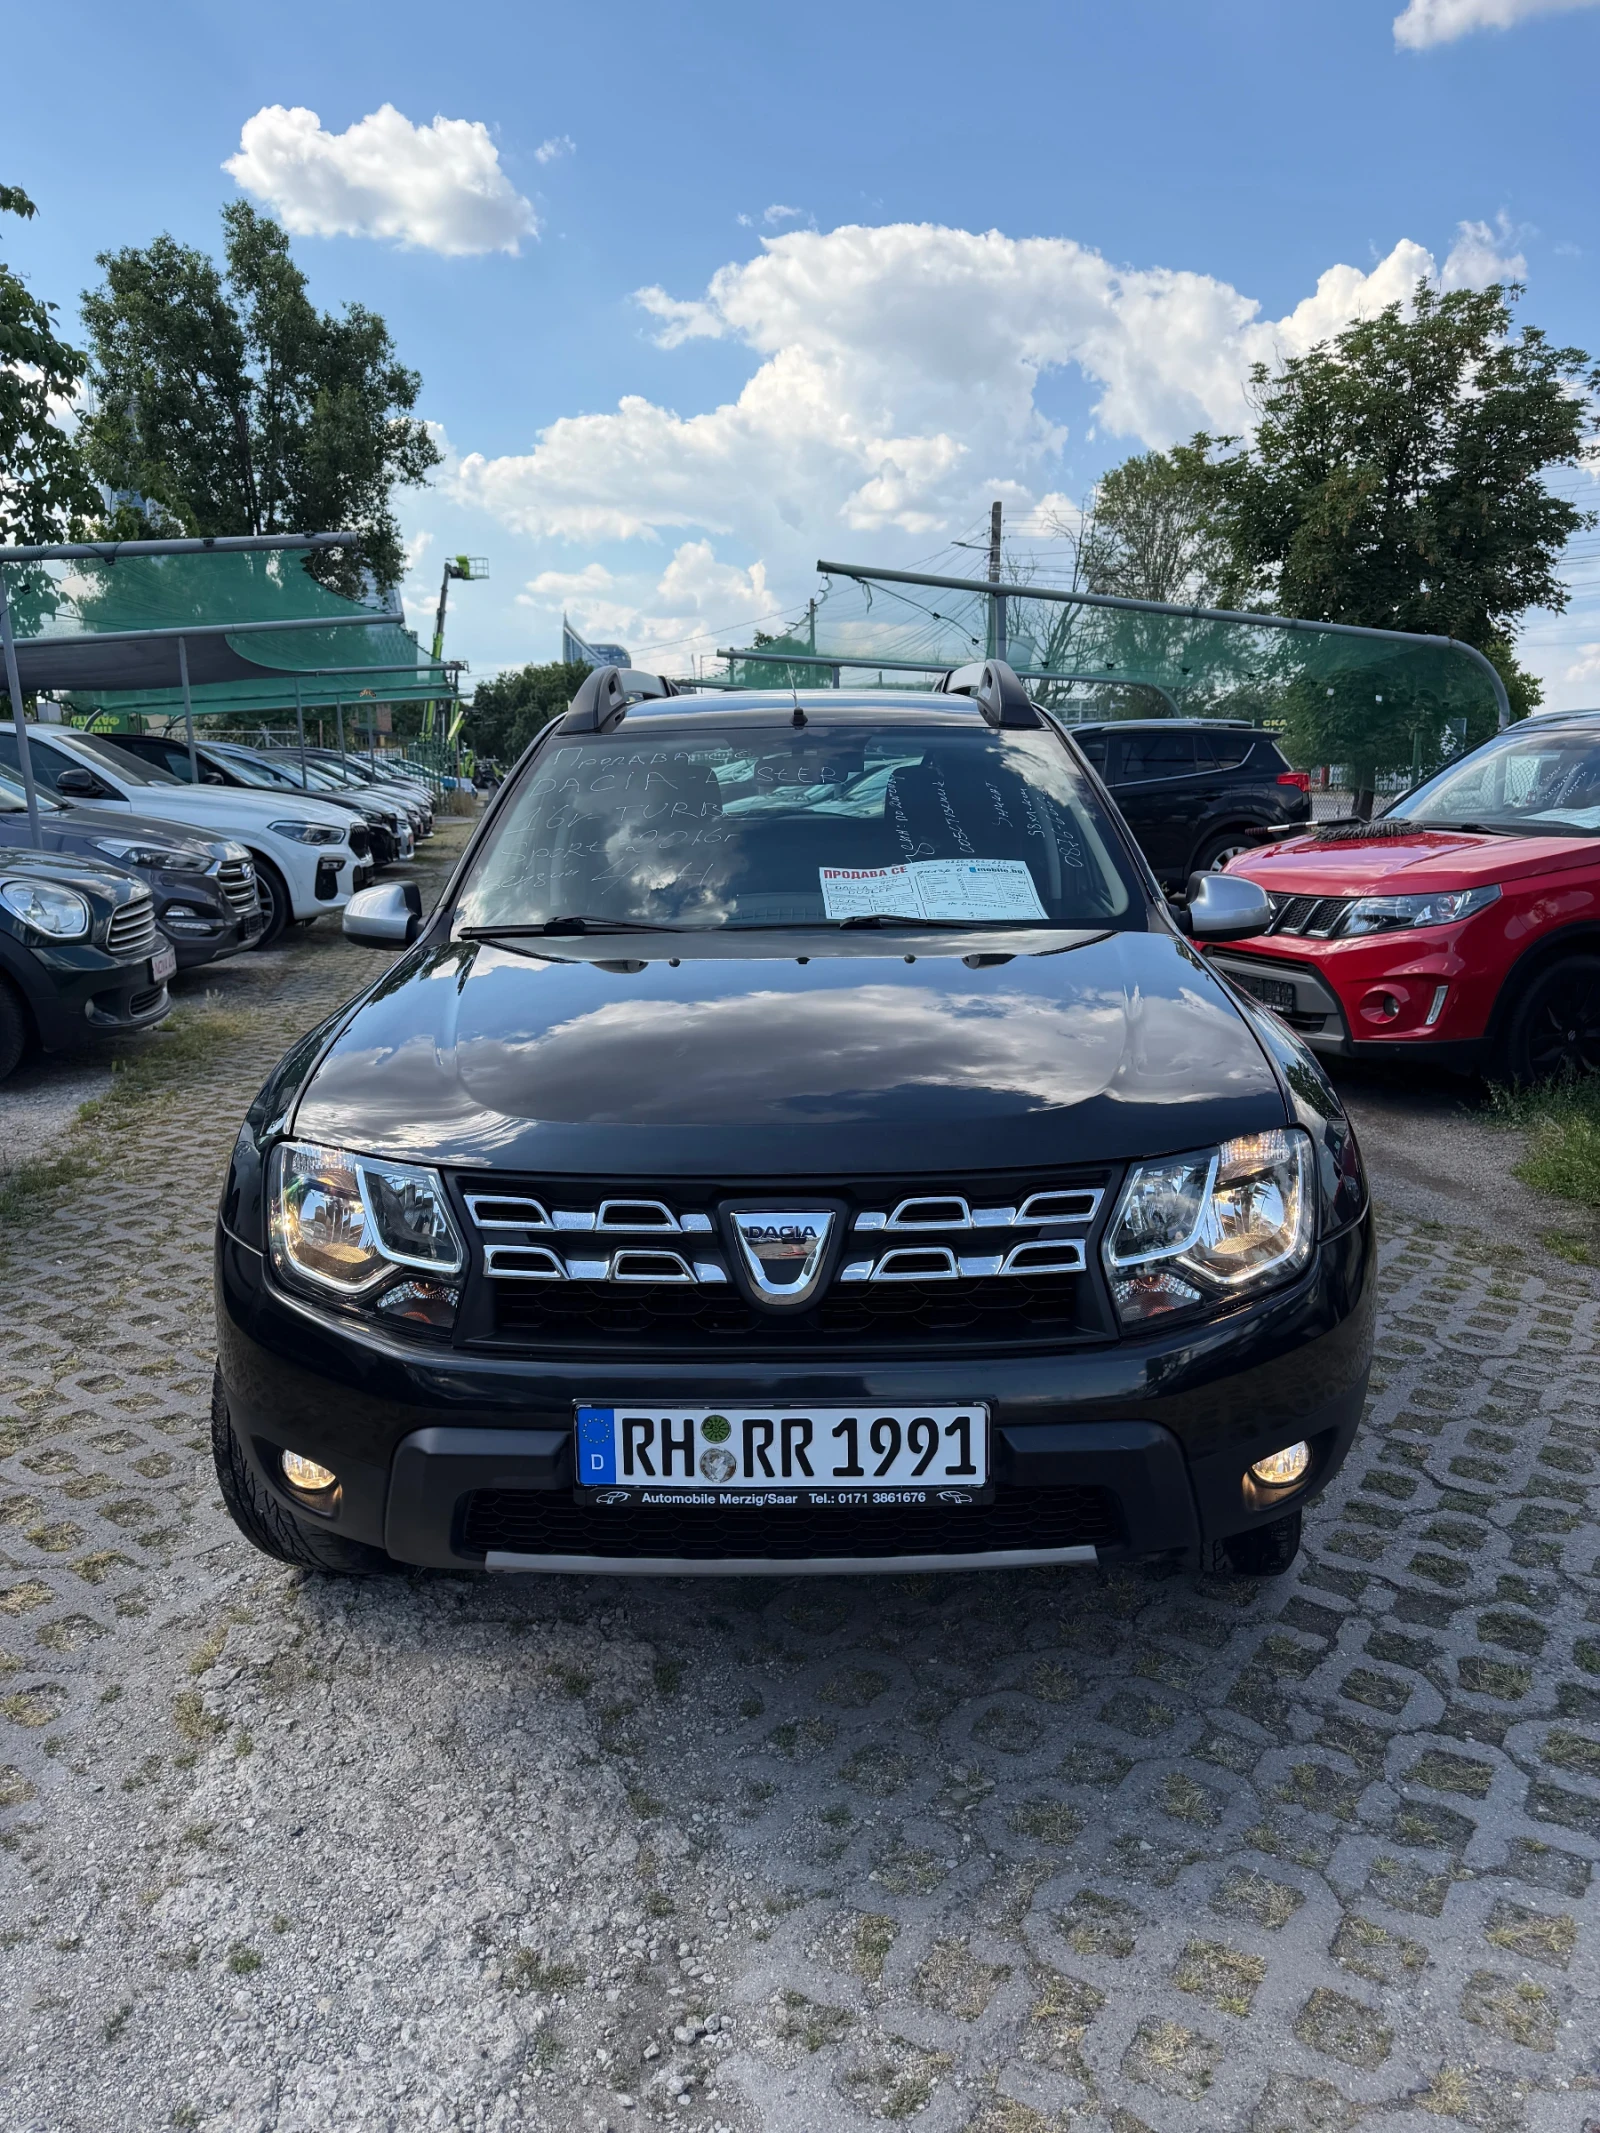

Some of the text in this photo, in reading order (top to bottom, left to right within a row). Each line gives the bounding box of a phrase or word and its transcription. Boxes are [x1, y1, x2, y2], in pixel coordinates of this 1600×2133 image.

[823, 869, 888, 880] ПРОДАВА
[891, 865, 909, 875] СЕ
[746, 1225, 818, 1239] DACIA
[590, 1416, 977, 1478] D RH RR 1991
[641, 1492, 926, 1507] Automobile Merzig/Saar Tel.: 0171 3861676
